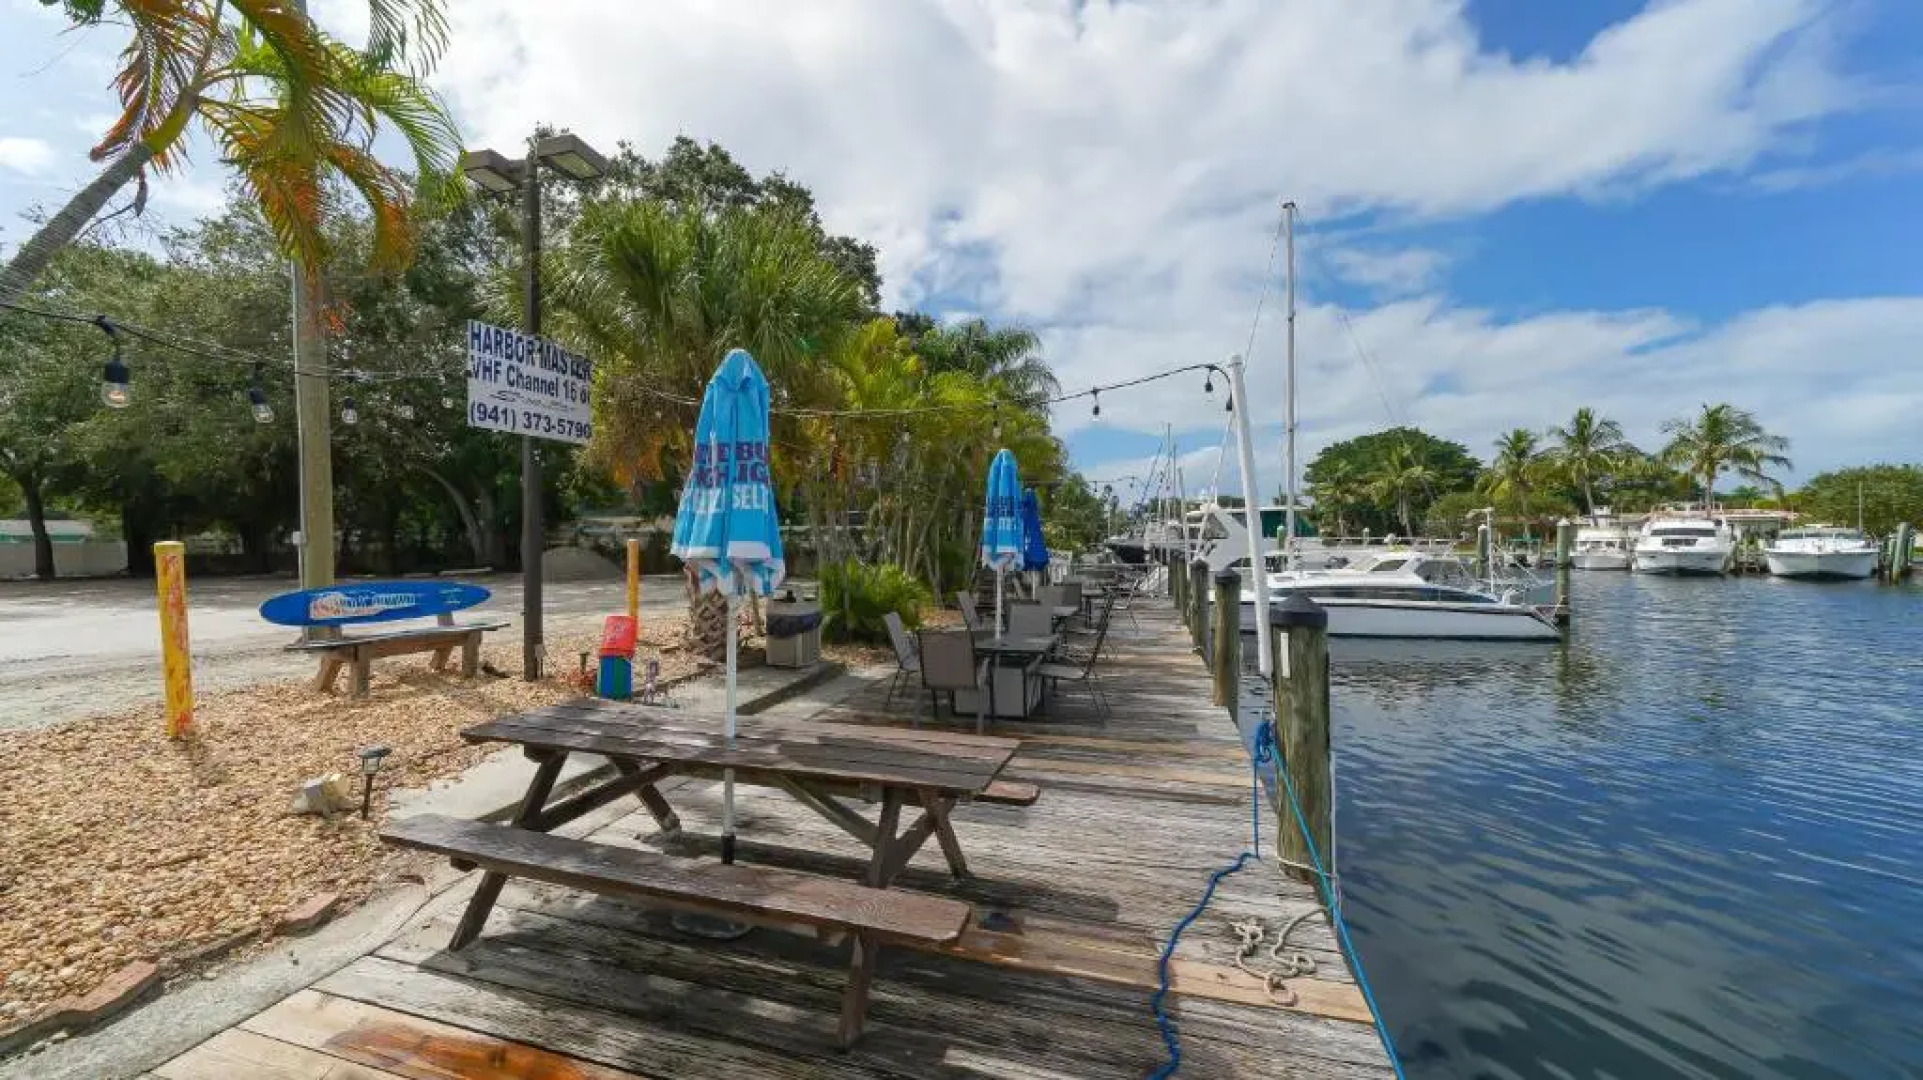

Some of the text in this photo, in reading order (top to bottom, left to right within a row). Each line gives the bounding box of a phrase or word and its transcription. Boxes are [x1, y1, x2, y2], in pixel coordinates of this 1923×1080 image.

[470, 321, 536, 367] HARBOR
[471, 354, 502, 384] VHF
[506, 365, 559, 398] Channel
[563, 378, 577, 403] 16
[470, 400, 517, 431] (941)
[522, 410, 593, 440] 373-5790
